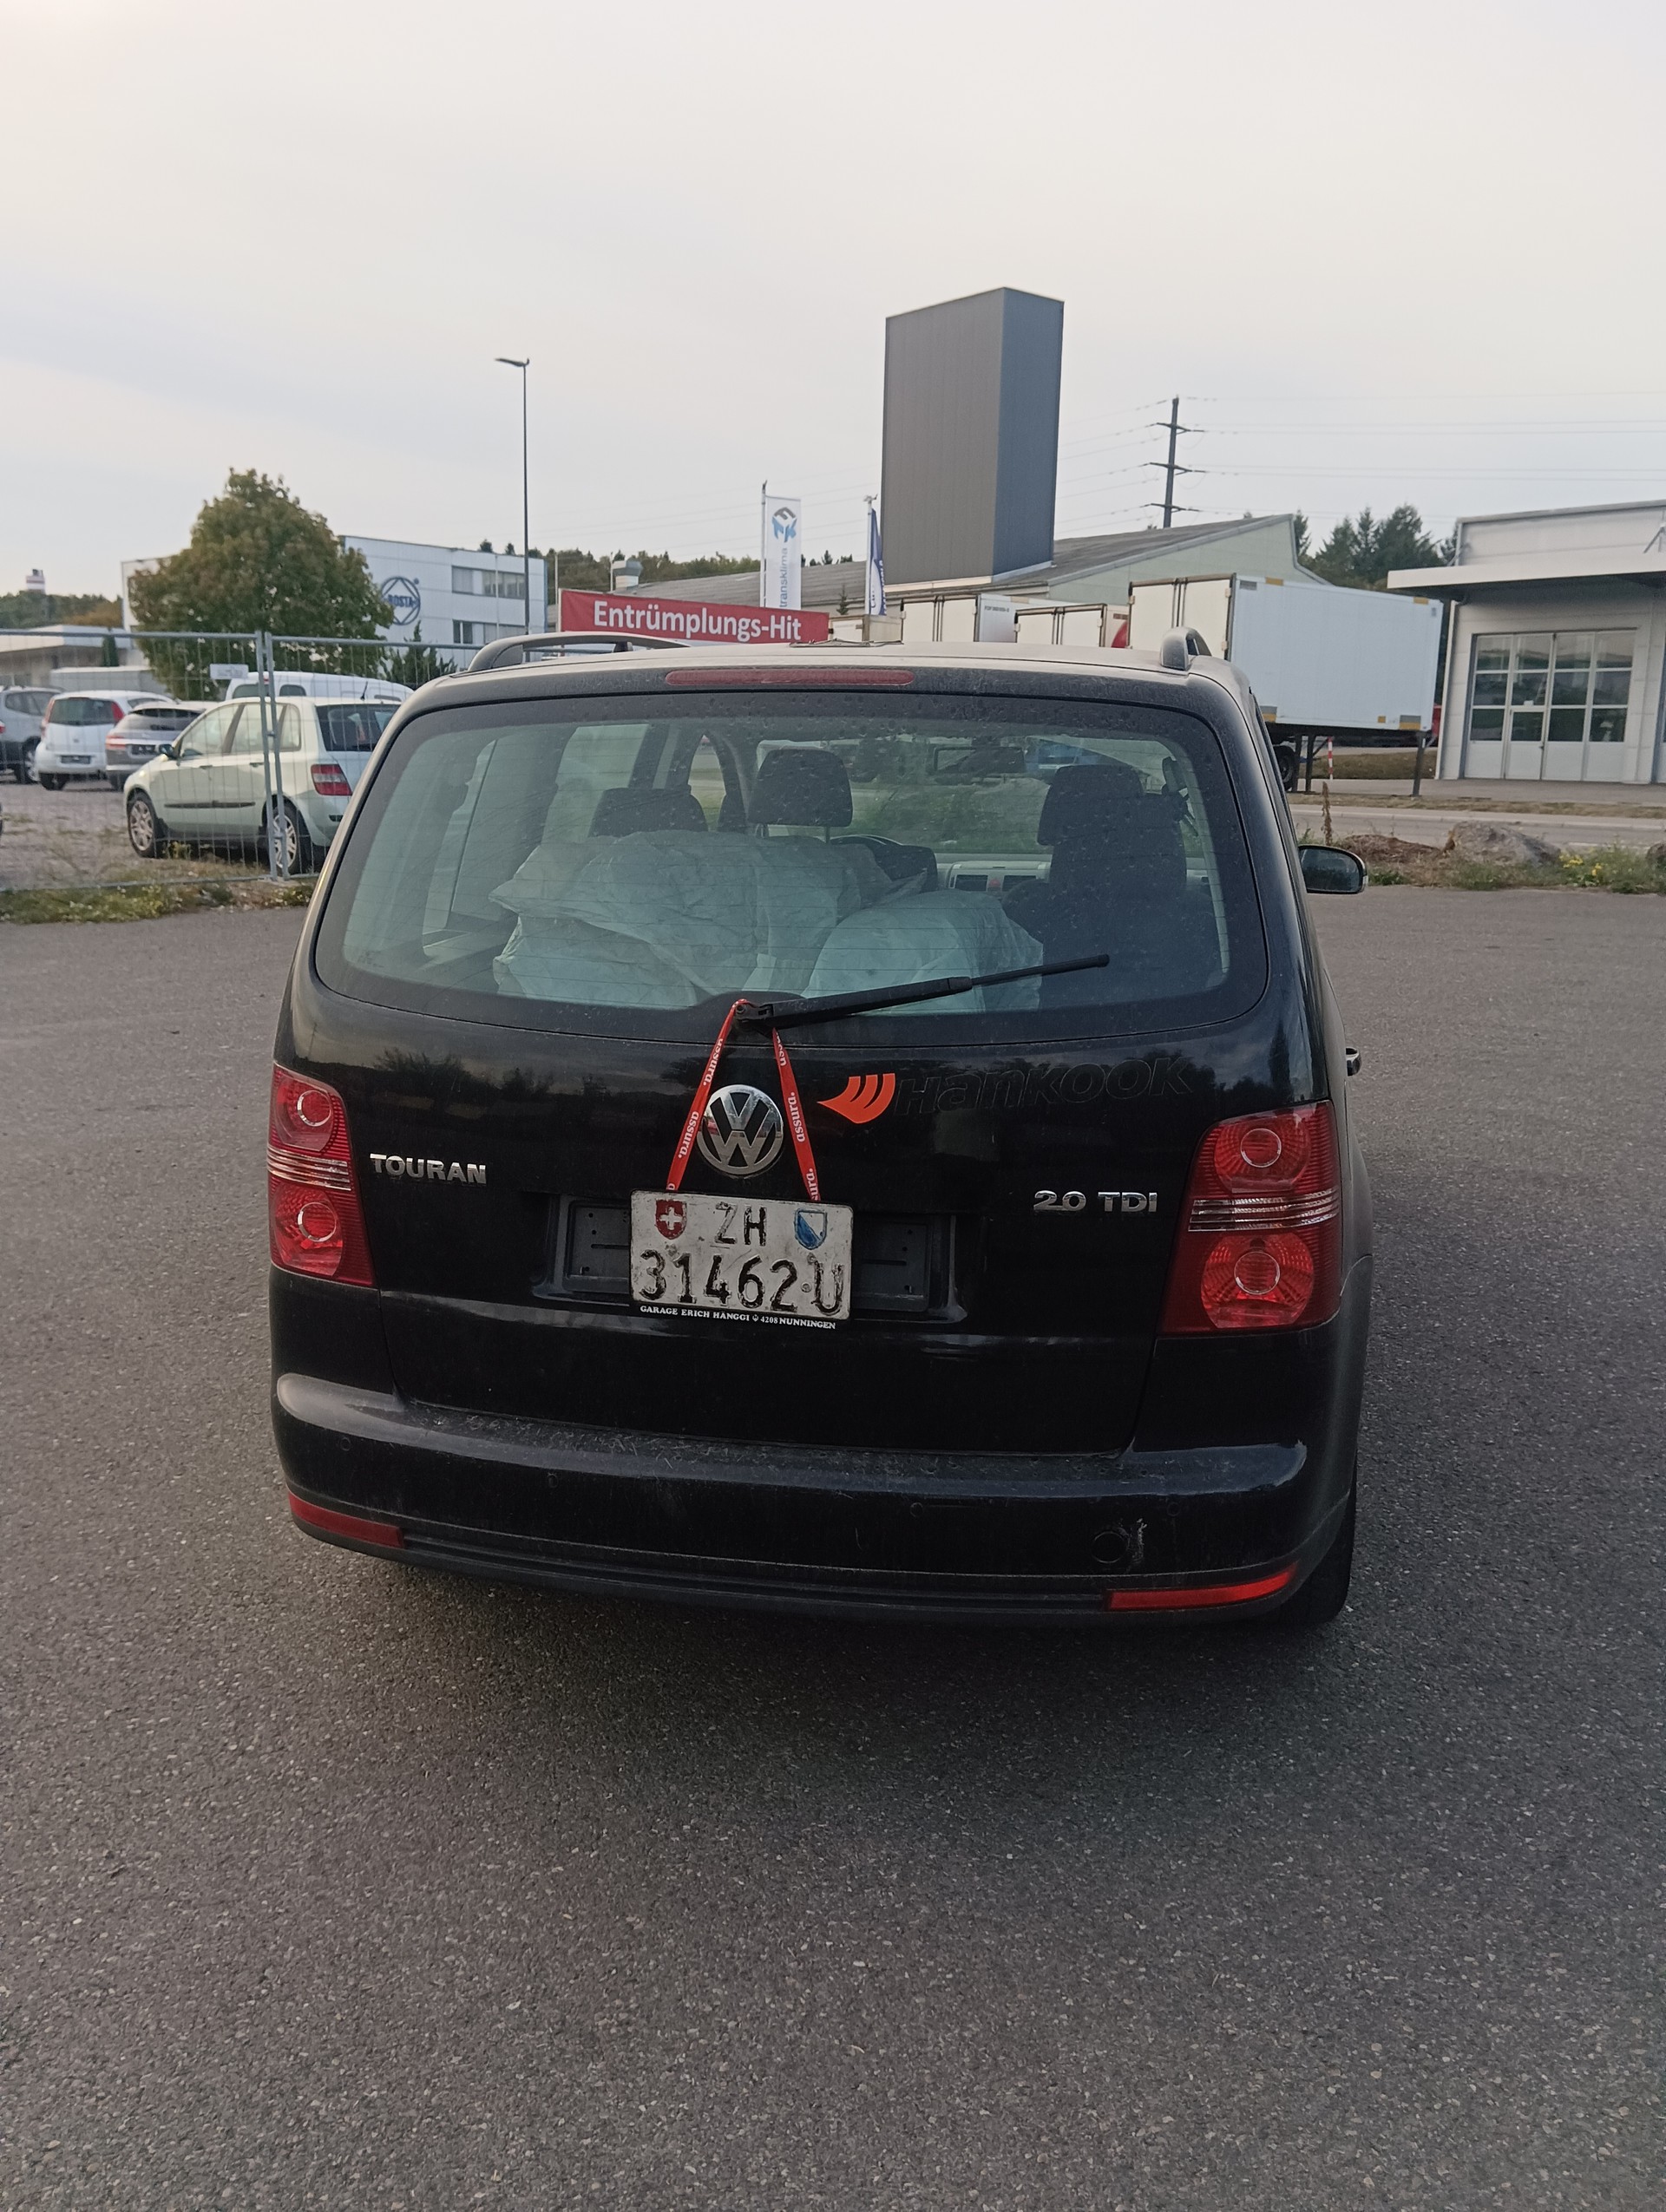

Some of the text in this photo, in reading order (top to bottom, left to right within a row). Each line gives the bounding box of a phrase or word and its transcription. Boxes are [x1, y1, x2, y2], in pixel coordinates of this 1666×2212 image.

[594, 599, 802, 642] Entrümplungs-Hit
[678, 1110, 700, 1159] assura.
[787, 1091, 806, 1142] assura.
[370, 1153, 488, 1185] TOURAN
[1098, 1191, 1158, 1212] TDI
[714, 1201, 768, 1247] ZH
[640, 1305, 679, 1316] GARAGE
[680, 1308, 711, 1319] ERICH
[760, 1315, 779, 1325] 4208
[778, 1317, 836, 1330] NUNNINGEN
